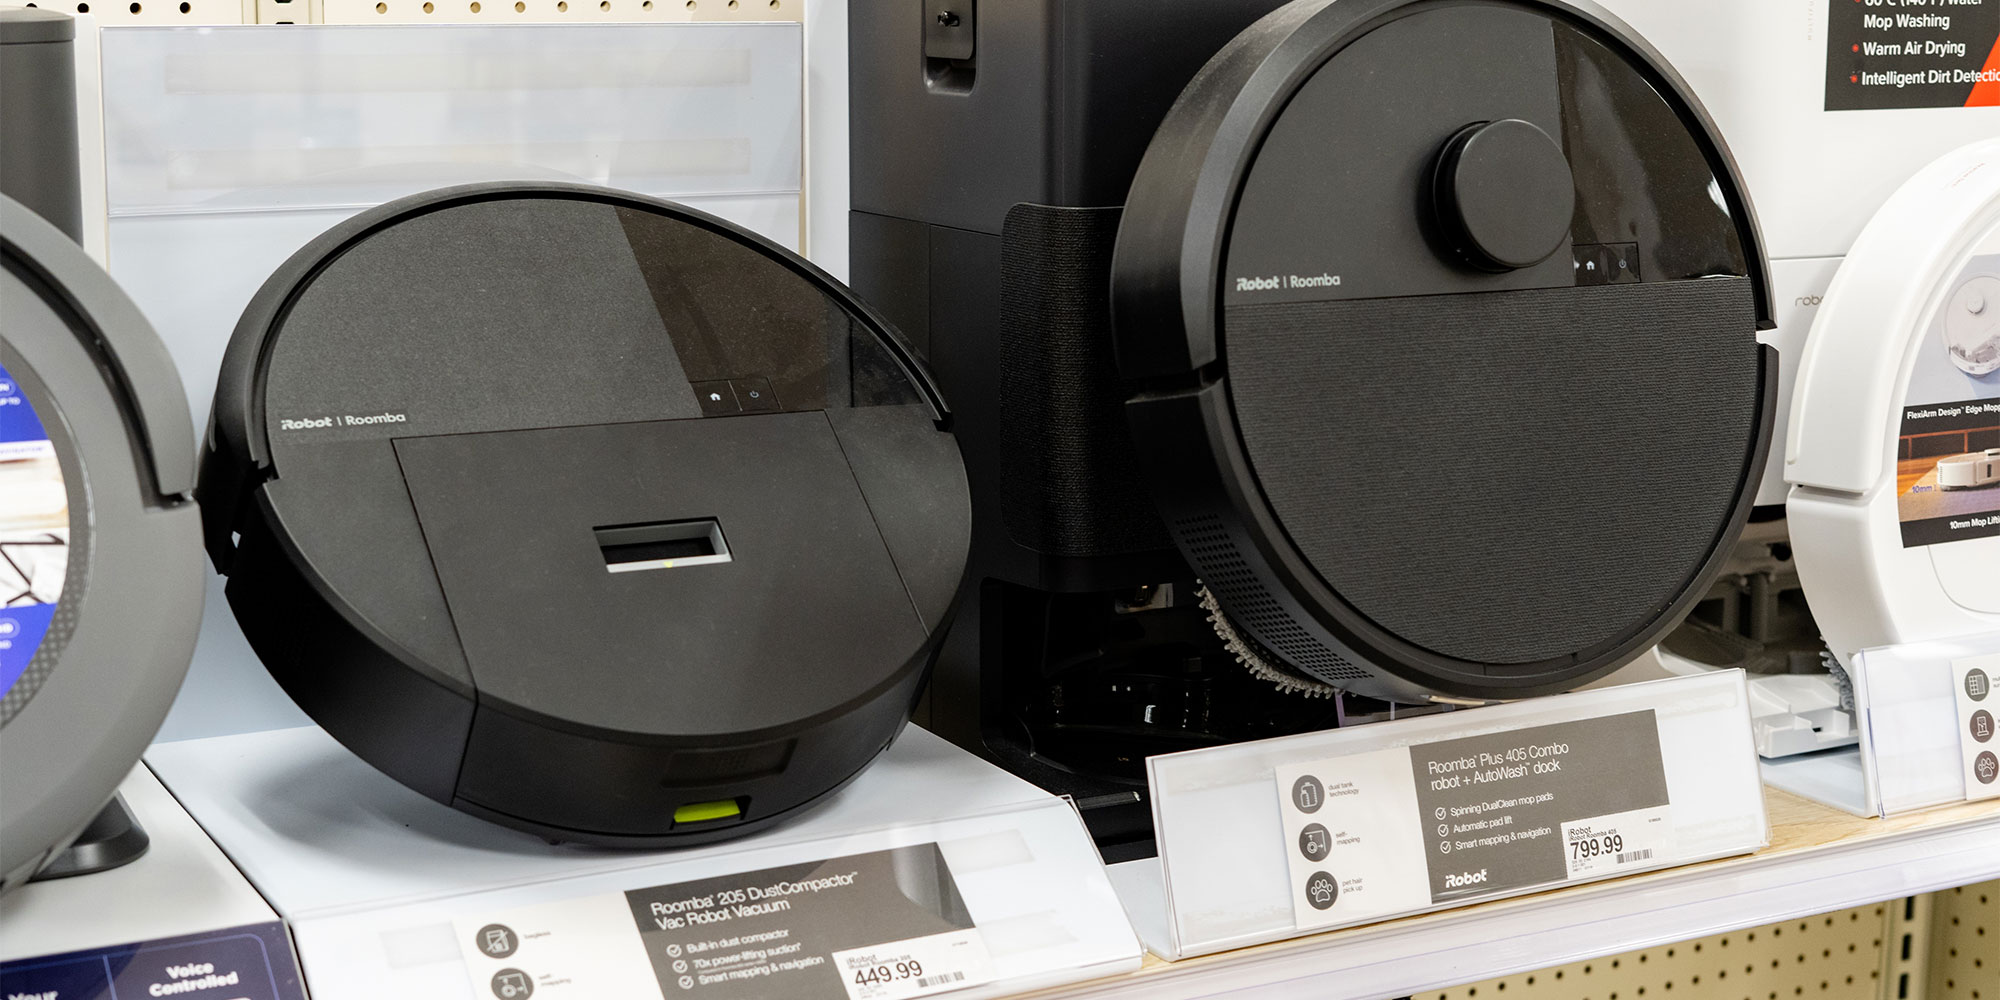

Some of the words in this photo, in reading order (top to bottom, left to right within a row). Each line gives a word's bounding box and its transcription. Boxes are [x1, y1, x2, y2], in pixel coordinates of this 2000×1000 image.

[1864, 14, 1893, 31] Mop
[1896, 13, 1950, 30] Washing
[1863, 42, 1901, 56] Warm
[1904, 41, 1922, 55] Air
[1925, 41, 1966, 57] Drying
[1862, 71, 1925, 88] Intelligent
[1928, 70, 1951, 83] Dirt
[1237, 275, 1280, 291] iRobot
[1290, 273, 1341, 288] Roomba
[1795, 294, 1824, 307] rob
[281, 417, 333, 430] iRobot
[345, 412, 406, 426] Roomba
[1907, 410, 1937, 420] FlexiArm
[1965, 404, 1983, 415] Edge
[1950, 520, 1970, 530] 10mm
[1971, 518, 1987, 528] Mop
[1480, 753, 1503, 767] Plus
[1506, 748, 1527, 762] 405
[1529, 742, 1569, 759] Combo
[1431, 775, 1461, 791] robot
[1463, 776, 1471, 786] +
[1534, 759, 1561, 774] dock
[1451, 804, 1481, 817] Spinning
[1482, 799, 1518, 812] DualClean
[1518, 796, 1535, 805] mop
[1536, 792, 1554, 804] pads
[1453, 819, 1489, 833] Automatic
[1489, 817, 1503, 829] pad
[1504, 815, 1513, 825] lift
[1568, 826, 1592, 837] iRobot
[1455, 839, 1478, 851] Smart
[1479, 834, 1510, 846] mapping
[1510, 832, 1517, 841] &
[1517, 827, 1552, 839] navigation
[1570, 834, 1623, 860] 799.99
[1445, 868, 1488, 889] iRobot
[717, 889, 746, 906] 205
[655, 917, 686, 930] Vac
[686, 907, 732, 925] Robot
[731, 899, 791, 918] Vacuum
[686, 941, 719, 954] Built-in
[719, 937, 740, 948] dust
[741, 929, 789, 943] compactor
[692, 958, 711, 969] 70x
[712, 949, 767, 967] power-lifting
[166, 963, 215, 979] Voice
[698, 972, 728, 985] Smart
[729, 964, 770, 979] mapping
[770, 963, 779, 972] &
[780, 956, 825, 970] navigation
[855, 960, 923, 986] 449.99
[149, 971, 239, 997] Controlled
